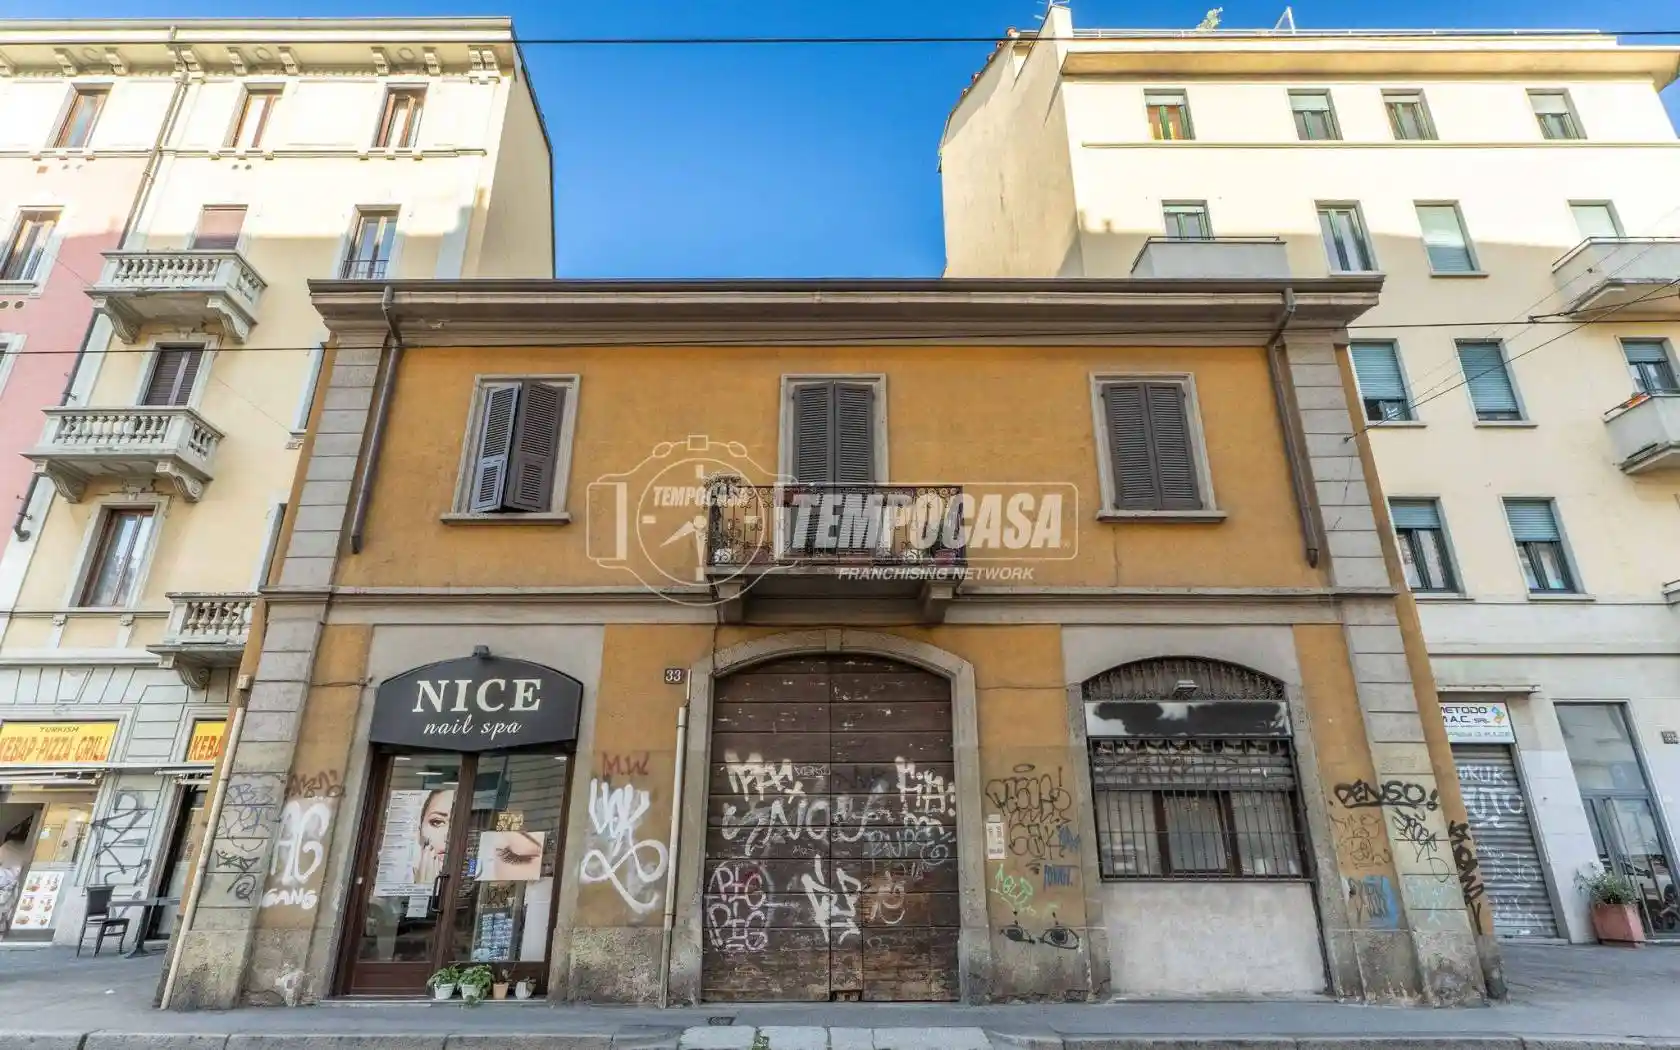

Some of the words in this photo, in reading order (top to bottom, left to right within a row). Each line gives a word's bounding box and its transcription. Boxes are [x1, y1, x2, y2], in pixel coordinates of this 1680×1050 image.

[665, 669, 682, 682] 33
[412, 678, 542, 713] NICE
[39, 726, 80, 734] TURKISH
[423, 713, 474, 735] nail
[480, 720, 522, 741] spa
